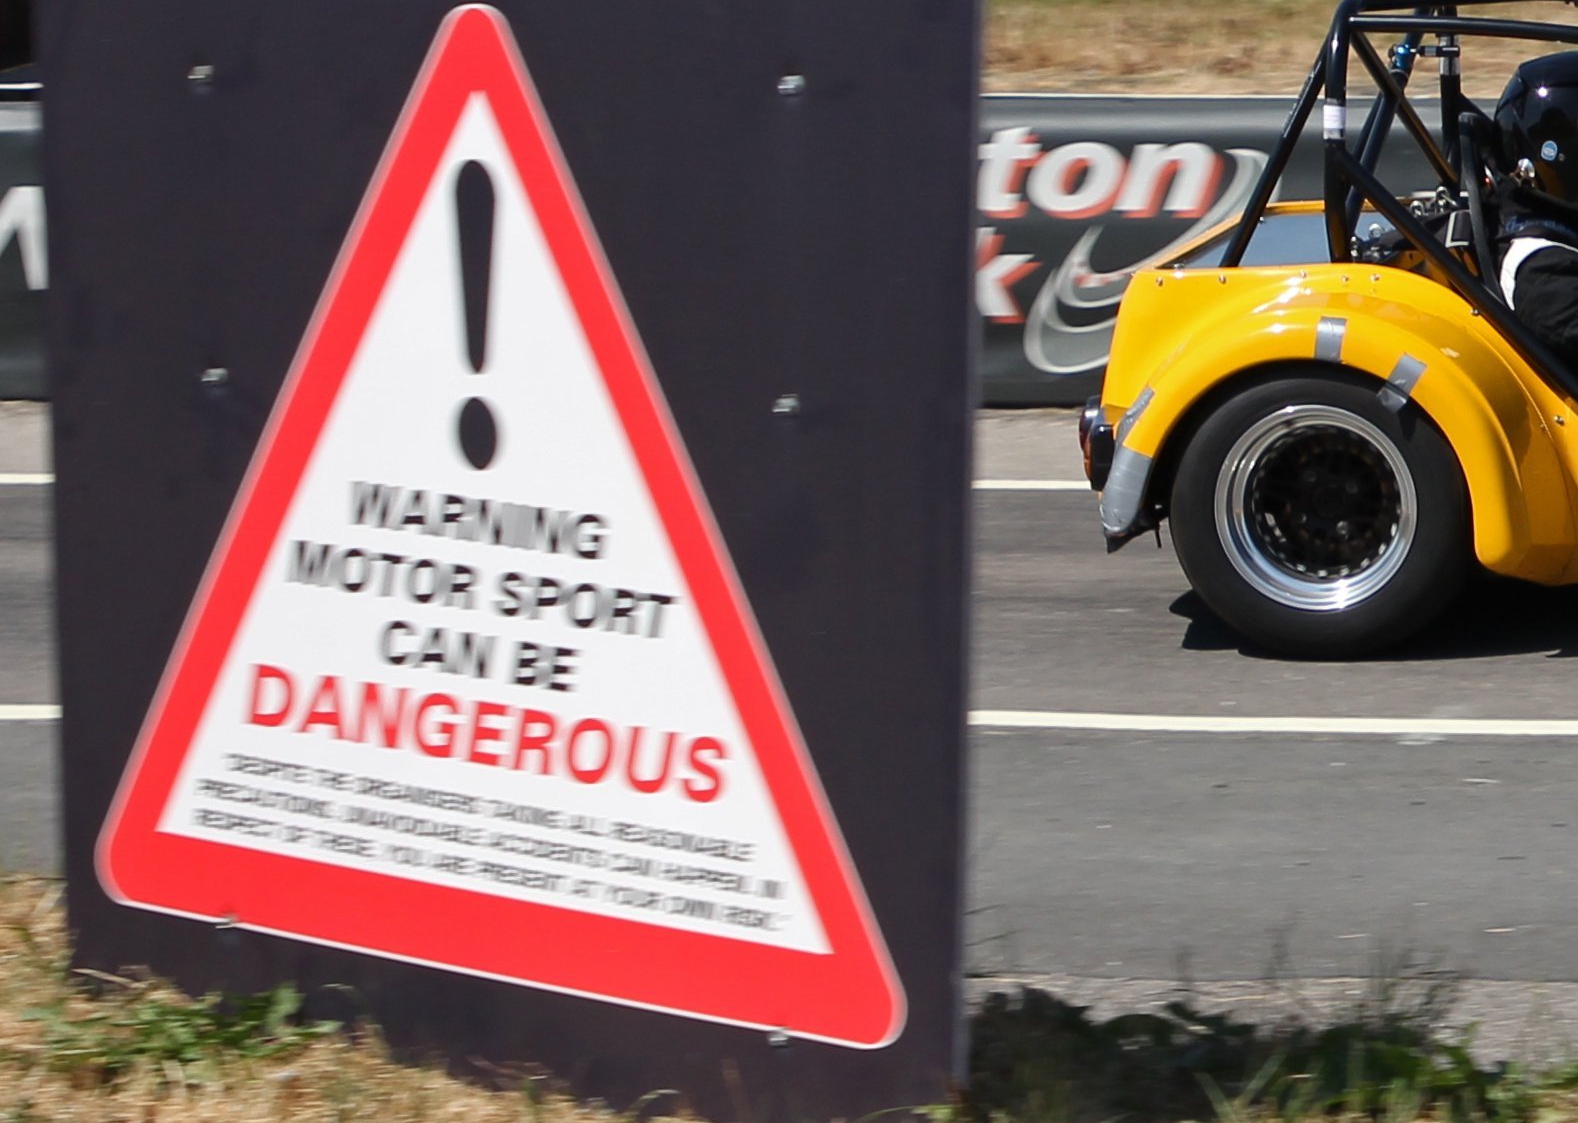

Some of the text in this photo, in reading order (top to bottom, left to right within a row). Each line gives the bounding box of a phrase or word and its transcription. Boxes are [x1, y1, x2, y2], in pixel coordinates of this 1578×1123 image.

[350, 480, 612, 560] WARNING
[286, 539, 681, 639] MOTOR SPORT
[379, 620, 580, 692] CAN BE
[241, 662, 732, 804] DANGEROUS
